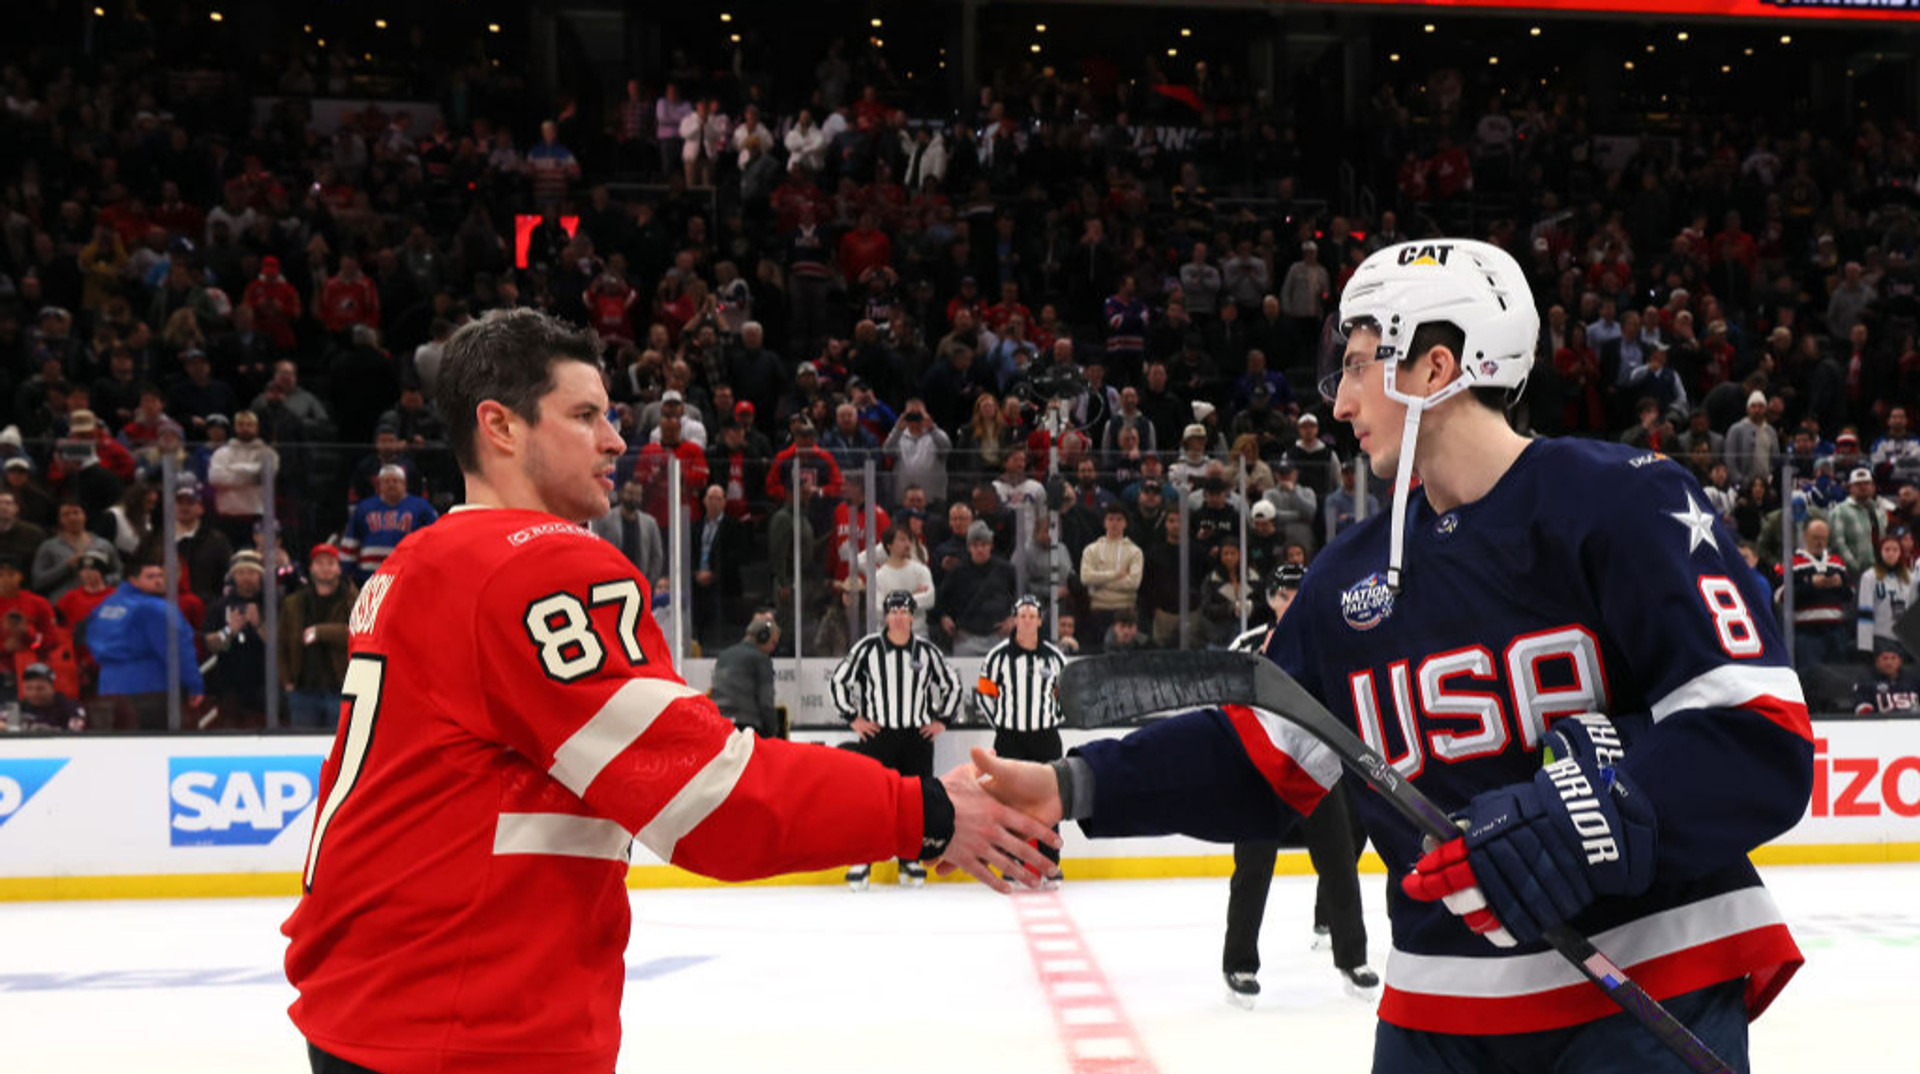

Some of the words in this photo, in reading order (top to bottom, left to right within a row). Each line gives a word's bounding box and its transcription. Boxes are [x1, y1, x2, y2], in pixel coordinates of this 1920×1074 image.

[1398, 244, 1454, 266] CAT
[523, 577, 649, 684] 87
[1697, 574, 1763, 658] 8
[1349, 623, 1613, 782] USA
[171, 771, 312, 832] SAP
[303, 652, 387, 894] 7
[1811, 738, 1920, 818] izo
